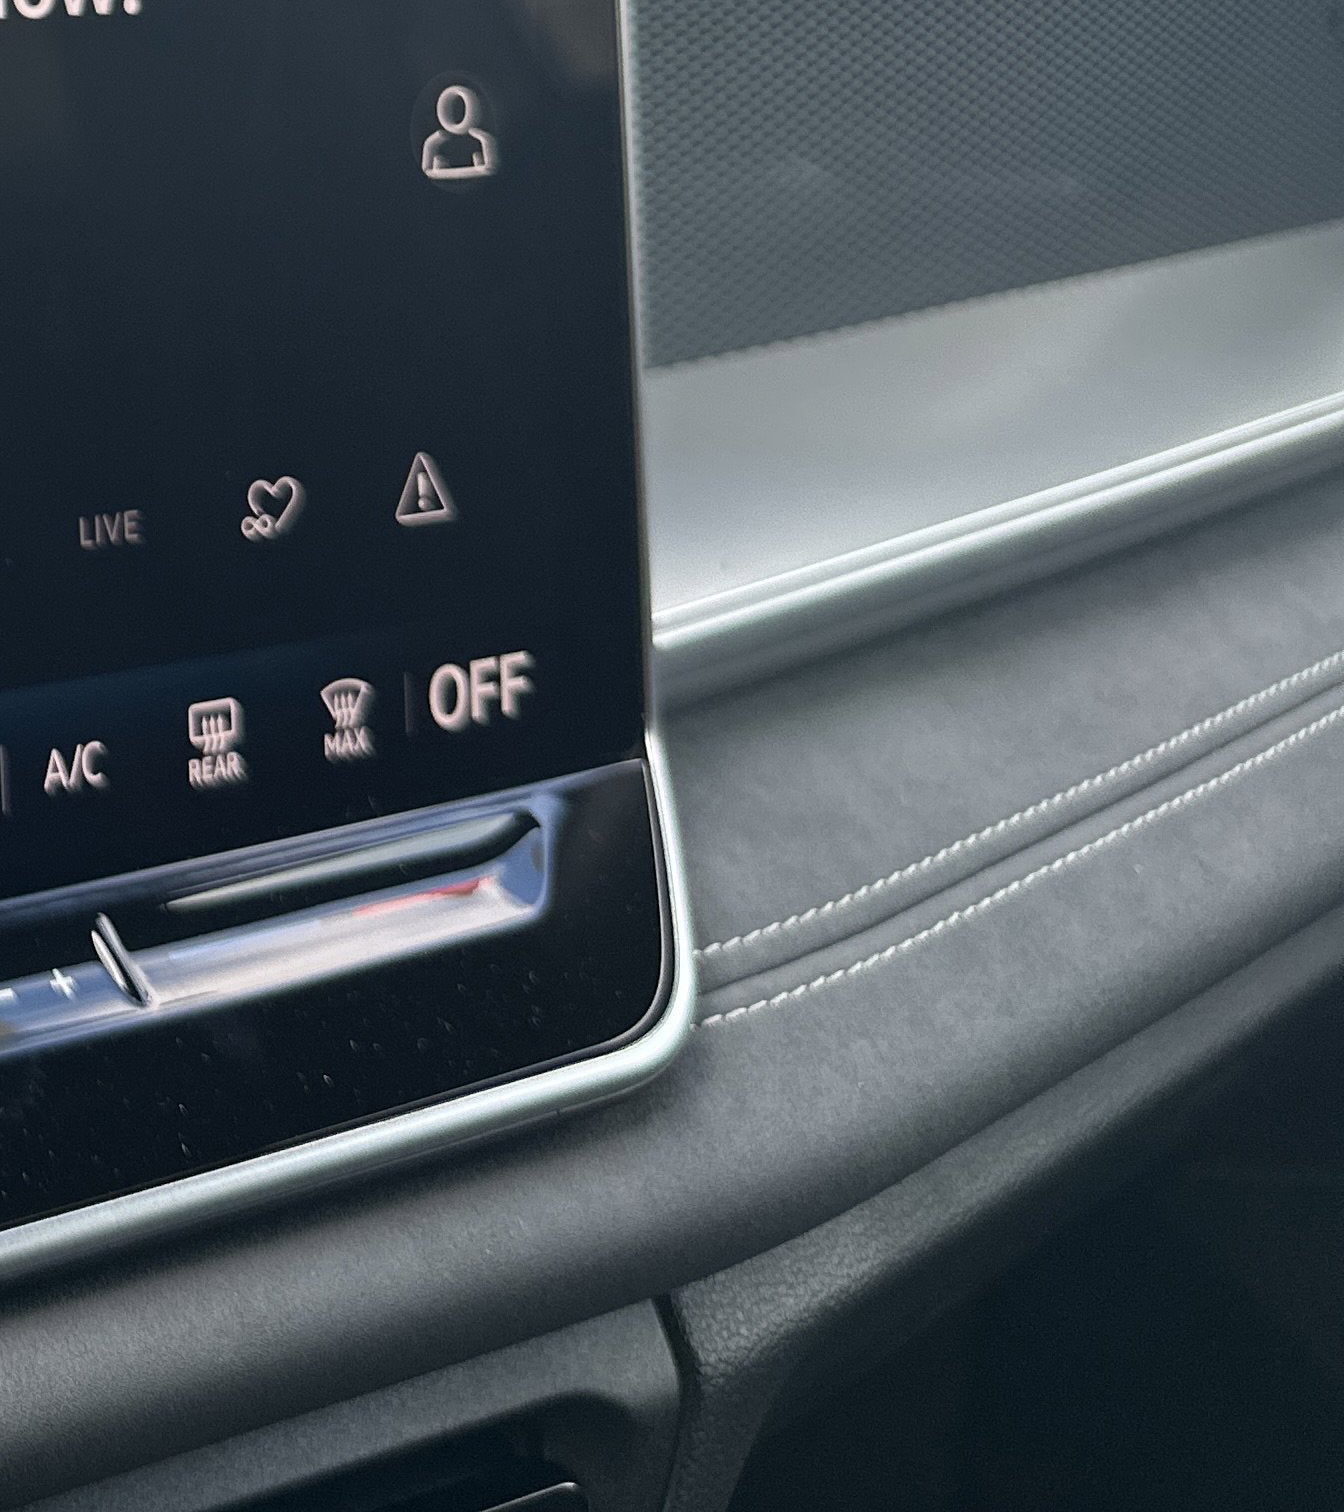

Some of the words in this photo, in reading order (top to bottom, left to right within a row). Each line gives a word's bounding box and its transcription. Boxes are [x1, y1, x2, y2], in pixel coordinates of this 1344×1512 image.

[79, 509, 143, 550] LIVE
[428, 650, 535, 732] OFF
[324, 725, 373, 760] MAX
[43, 740, 108, 794] A/C
[188, 751, 246, 788] REAR
